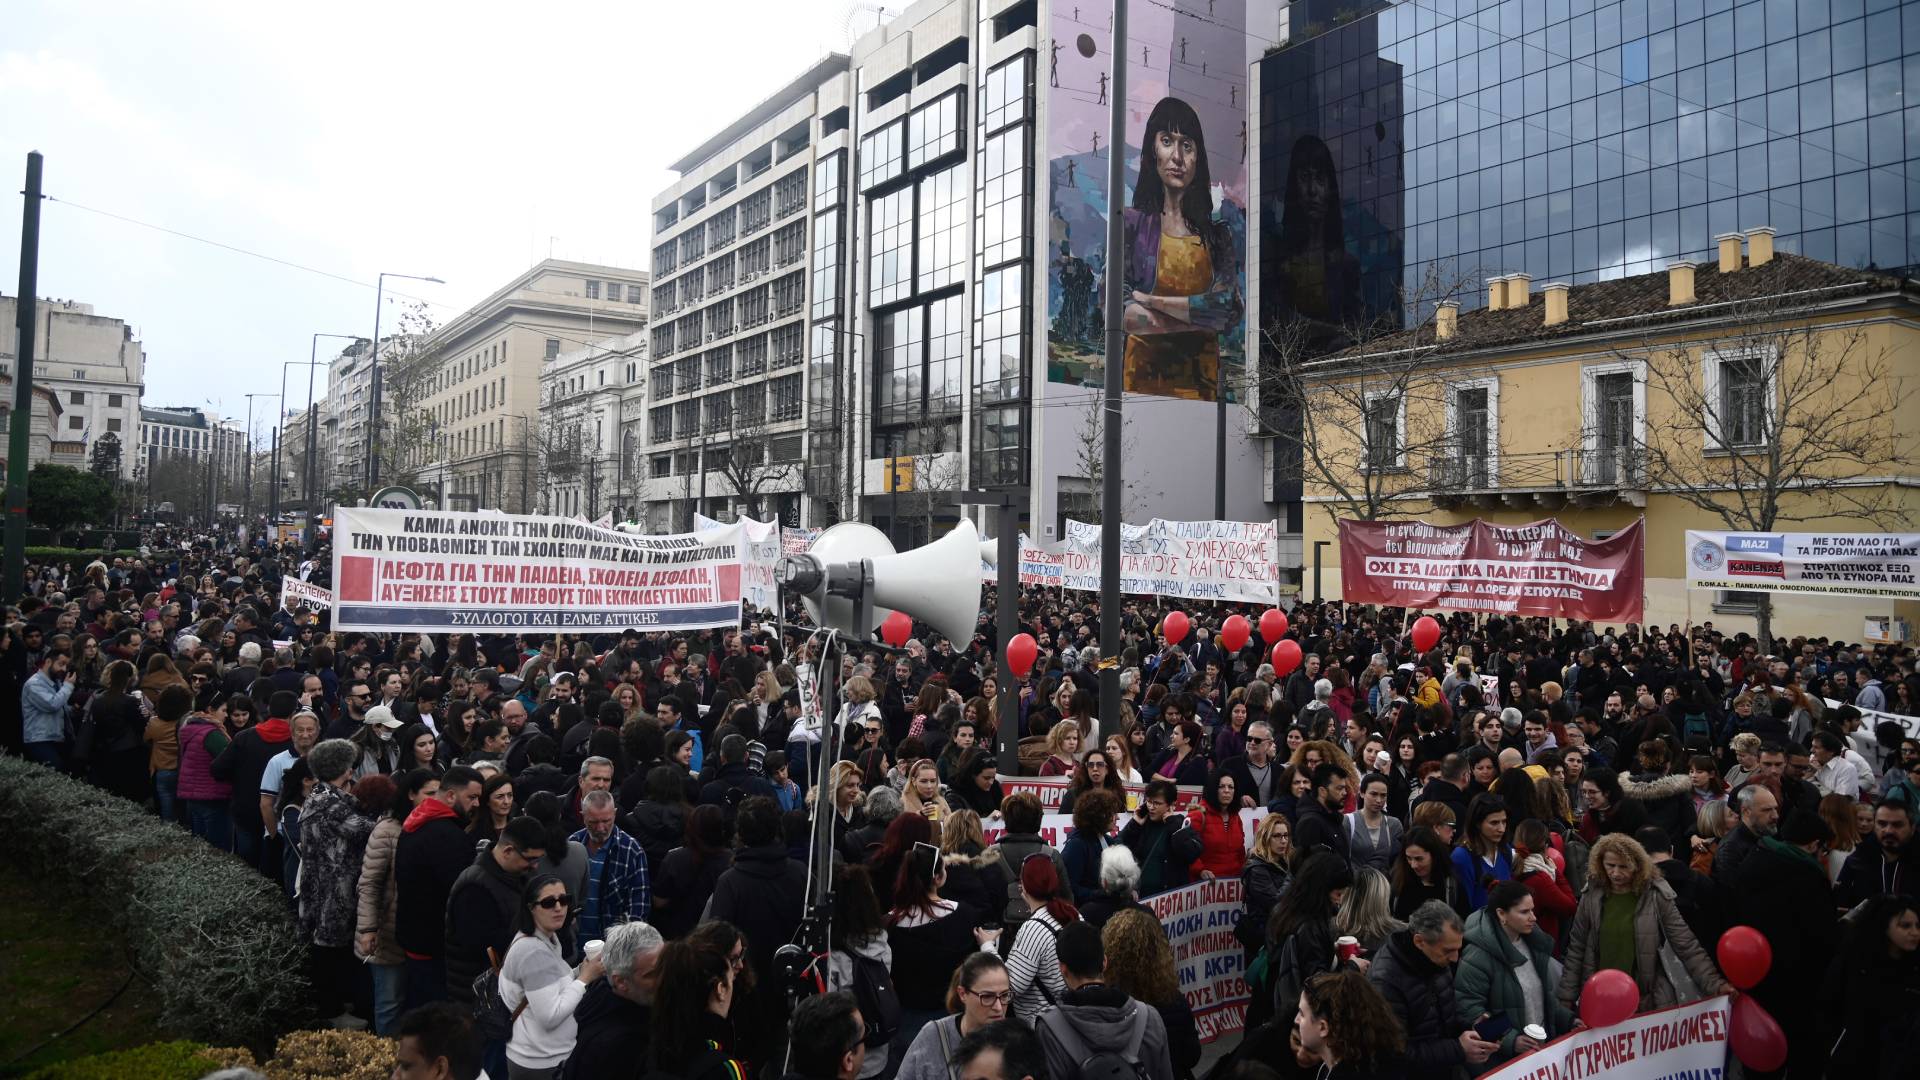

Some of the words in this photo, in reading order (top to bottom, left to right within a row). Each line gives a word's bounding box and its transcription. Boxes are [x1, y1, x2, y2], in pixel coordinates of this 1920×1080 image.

[404, 516, 455, 534] ΚΑΜΙΑ
[459, 519, 508, 537] ΑΝΟΧΗ
[512, 521, 548, 538] ΣΤΗΝ
[552, 523, 631, 547] ΟΙΚΟΝΟΜΙΚΗ
[631, 537, 703, 549] ΕΞΑΘΛΙΩΣΗ,
[1175, 522, 1212, 538] ΠΑΙΔΙΑ
[1216, 522, 1238, 538] ΣΤΑ
[1384, 524, 1395, 537] Το
[351, 533, 382, 550] ΤΗΝ
[387, 535, 487, 555] ΥΠΟΒΑΘΜΙΣΗ
[491, 540, 520, 556] ΤΩΝ
[523, 541, 588, 559] ΣΧΟΛΕΙΩΝ
[589, 547, 617, 562] ΜΑΣ
[621, 549, 644, 564] ΚΑΙ
[647, 550, 669, 564] ΤΗΝ
[671, 545, 736, 564] ΚΑΤΑΣΤΟΛΗ!
[1385, 540, 1402, 554] δεν
[1740, 540, 1769, 549] ΜΑΖΙ
[1812, 538, 1828, 546] ΜΕ
[1832, 538, 1854, 546] ΤΟΝ
[1858, 538, 1880, 546] ΛΑΟ
[1883, 538, 1900, 546] ΓΙΑ
[1560, 542, 1584, 560] ΜΑΣ
[1797, 547, 1810, 555] ΤΑ
[1813, 548, 1888, 556] ΠΡΟΒΛΗΜΑΤΑ
[1892, 548, 1918, 556] ΜΑΣ
[382, 560, 445, 581] ΛΕΦΤΑ
[450, 563, 477, 582] ΓΙΑ
[482, 564, 516, 583] ΤΗΝ
[520, 566, 586, 587] ΠΑΙΔΕΙΑ,
[650, 567, 712, 587] ΑΣΦΑΛΗ,
[1066, 553, 1090, 570] ΤΟΝ
[1120, 555, 1139, 572] ΓΙΑ
[1190, 560, 1212, 577] ΚΑΙ
[1216, 560, 1236, 578] ΤΙΣ
[1368, 560, 1395, 574] ΟΧΙ
[1399, 562, 1420, 575] ΣΤΑ
[1424, 564, 1482, 577] ΙΔΙΩΤΙΚΑ
[1486, 564, 1609, 587] ΠΑΝΕΠΙΣΤΗΜΙΑ
[1730, 562, 1782, 572] ΚΑΝΕΝΑΣ
[1803, 563, 1884, 572] ΣΤΡΑΤΙΩΤΙΚΟΣ
[1886, 564, 1910, 572] ΕΞΩ
[1843, 573, 1888, 582] ΣΥΝΟΡΑ
[1892, 574, 1915, 584] ΜΑΣ
[382, 583, 457, 602] ΑΥΞΗΣΕΙΣ
[460, 586, 507, 604] ΣΤΟΥΣ
[511, 587, 574, 605] ΜΙΣΘΟΥΣ
[578, 588, 604, 605] ΤΩΝ
[606, 587, 712, 606] ΕΚΠΑΙΔΕΥΤΙΚΩΝ!
[1428, 583, 1440, 592] ΜΕ
[1443, 583, 1469, 592] ΑΞΙΑ
[1475, 584, 1522, 596] ΔΩΡΕΑΝ
[1524, 586, 1583, 600] ΣΠΟΥΔΕΣ
[1829, 586, 1878, 594] ΑΠΟΣΤΡΑΤΩΝ
[451, 612, 527, 625] ΣΥΛΛΟΓΟΙ
[532, 613, 558, 625] ΚΑΙ
[562, 613, 602, 626] ΕΛΜΕ
[605, 612, 660, 625] ΑΤΤΙΚΗΣ
[1154, 892, 1182, 919] ΛΕΦΤΑ
[1186, 890, 1197, 911] ΓΙΑ
[1204, 954, 1245, 979] ΑΚΡΙ
[1641, 1010, 1727, 1056] ΥΠΟΔΟΜΕΣ!
